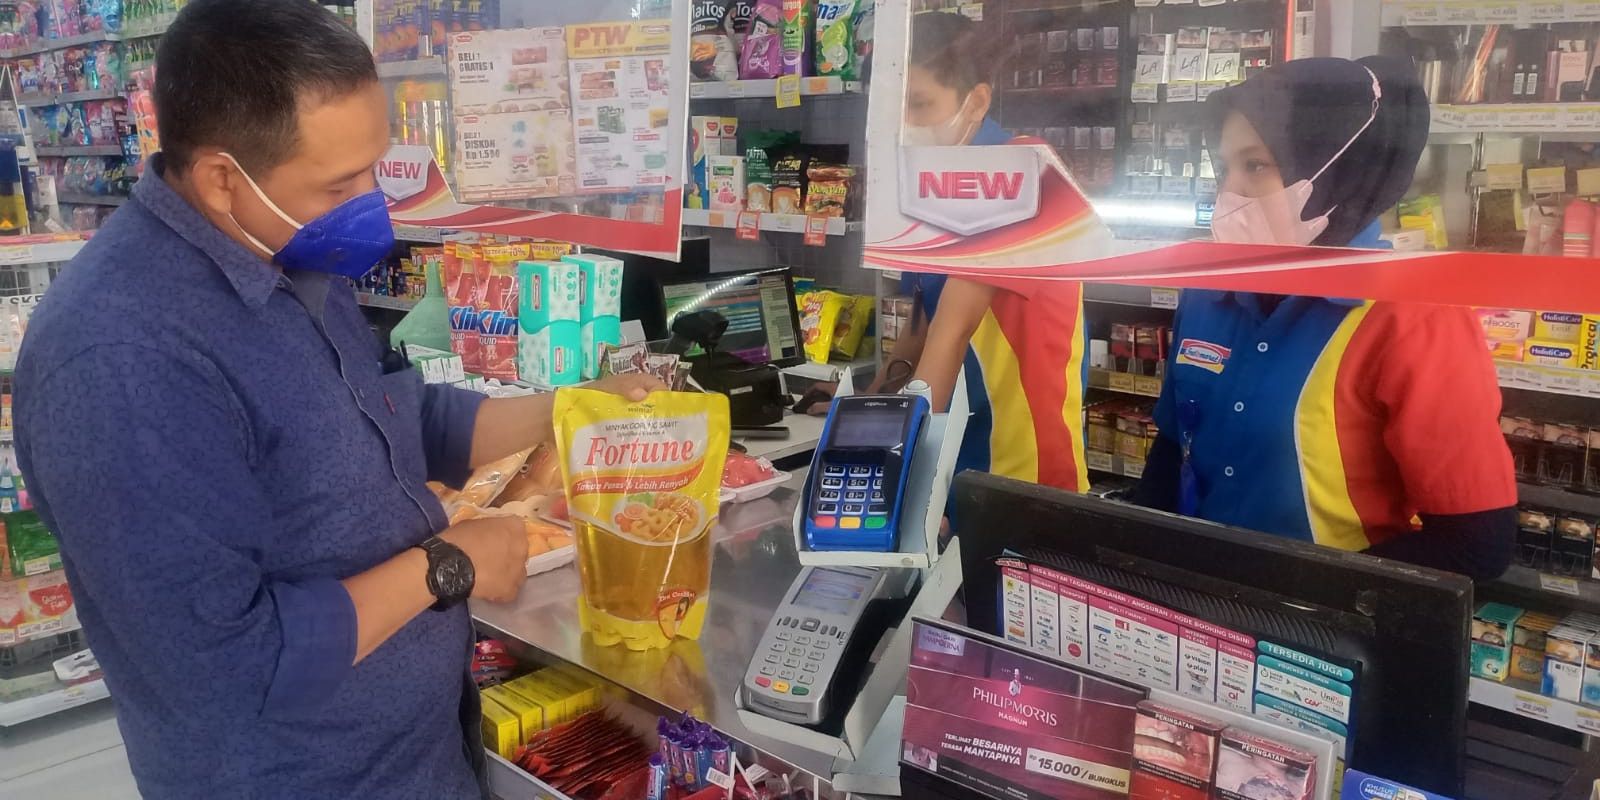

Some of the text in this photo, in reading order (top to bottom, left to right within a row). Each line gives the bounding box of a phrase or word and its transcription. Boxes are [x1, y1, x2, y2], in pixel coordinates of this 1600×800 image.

[575, 24, 632, 48] PTW
[459, 62, 488, 72] GRATIS
[1141, 62, 1157, 75] LA
[1182, 56, 1199, 69] LA
[1214, 60, 1232, 75] LA
[465, 140, 496, 149] DISKON
[378, 160, 421, 179] NEW
[918, 171, 1024, 200] NEW
[1531, 347, 1570, 358] HolistiCare
[605, 422, 629, 431] MINYAK
[584, 437, 694, 467] Fortune
[634, 479, 658, 490] Lebih
[659, 476, 689, 490] Renyah
[1032, 567, 1047, 575] BISA
[1047, 571, 1068, 583] BAYAR
[1069, 577, 1096, 592] TAGIHAN
[1097, 586, 1126, 601] BULANAN
[1132, 600, 1169, 616] ANGSURAN
[1174, 614, 1193, 625] KODE
[1194, 620, 1227, 637] BOOKING
[1228, 632, 1250, 645] DISINI
[1268, 644, 1343, 677] TERSEDIA JUGA
[998, 711, 1028, 727] MAGNUM
[1155, 713, 1195, 731] PERINGATAN
[945, 733, 1022, 756] TERLIHAT BESARNYA
[1241, 743, 1285, 763] PERINGATAN
[941, 742, 1021, 766] TERASA MANTAPNYA
[1087, 774, 1127, 788] BUNGKUS
